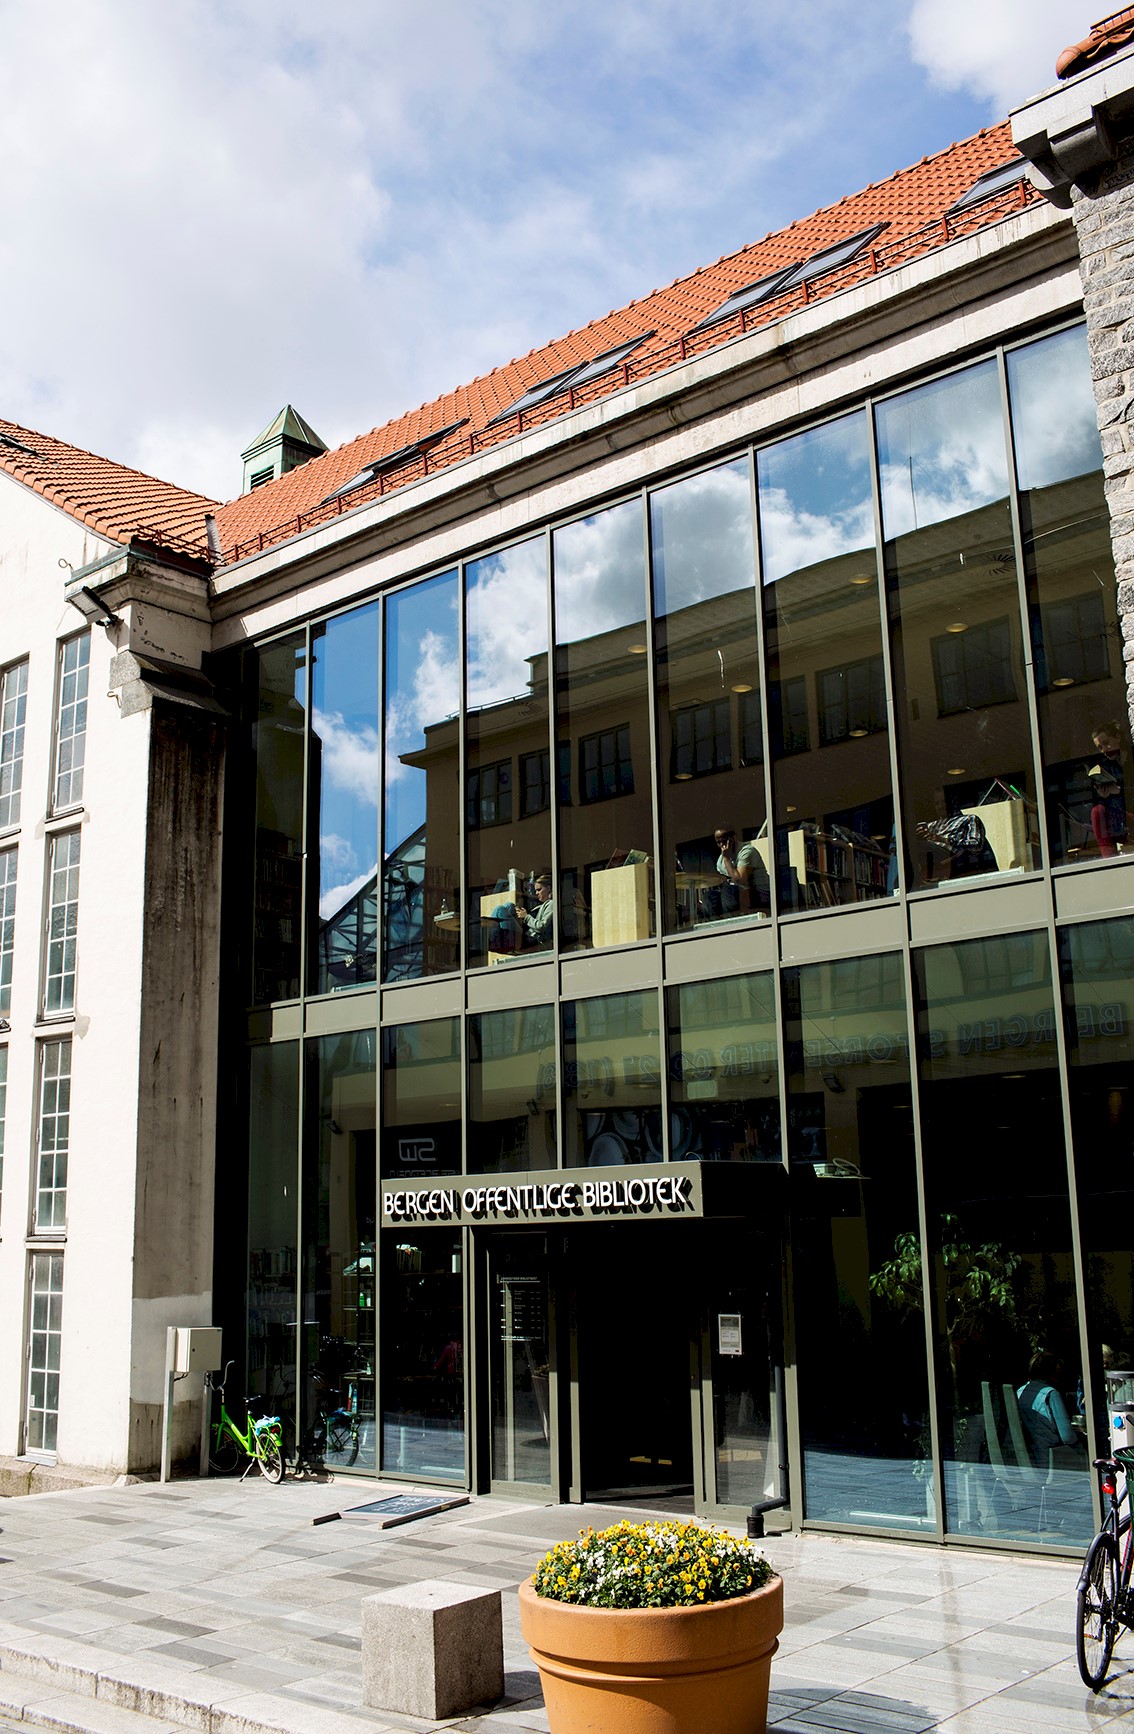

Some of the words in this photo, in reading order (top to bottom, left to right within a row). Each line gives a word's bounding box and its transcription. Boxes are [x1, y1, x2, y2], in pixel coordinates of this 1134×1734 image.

[383, 1188, 454, 1216] BERGEN
[462, 1182, 576, 1211] OFFENTLIGE
[582, 1176, 687, 1208] BIBLIOTEK
